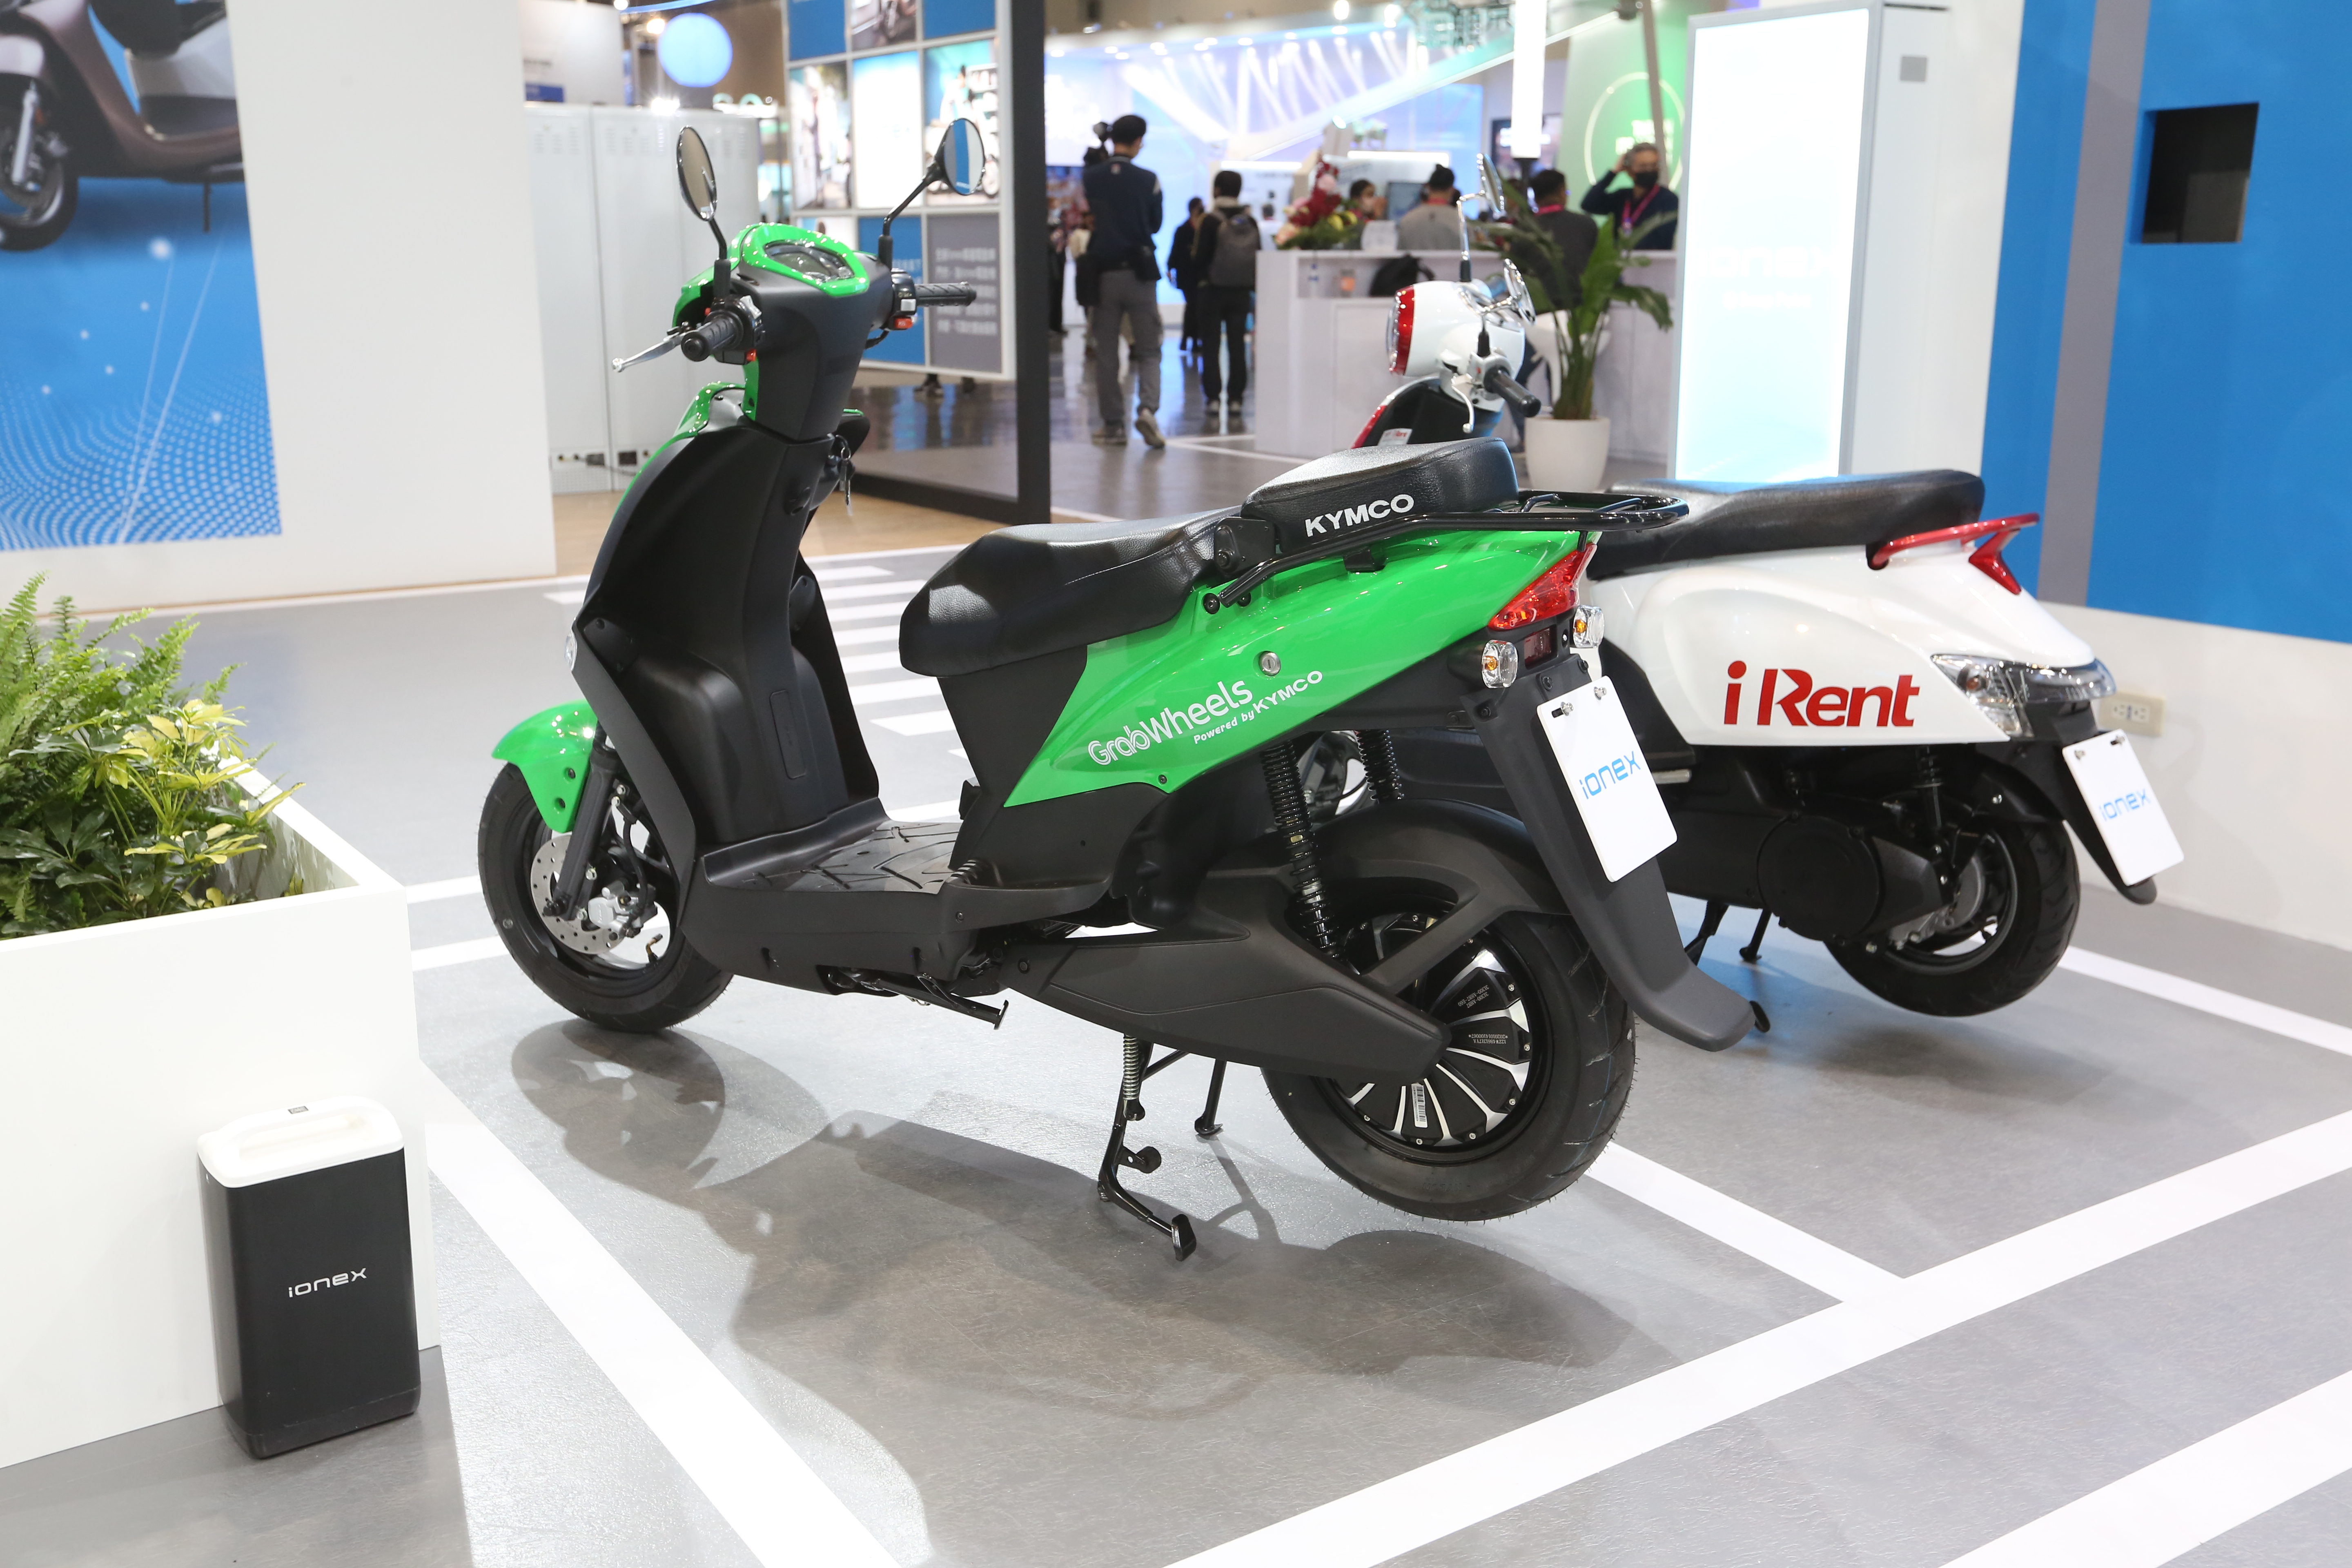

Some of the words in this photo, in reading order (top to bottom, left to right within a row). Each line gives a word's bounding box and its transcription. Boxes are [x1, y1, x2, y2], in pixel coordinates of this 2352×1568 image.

[1305, 494, 1414, 537] KYMCO
[1087, 679, 1253, 766] GrabWheels
[1193, 717, 1238, 744] Powered
[1241, 711, 1254, 722] by
[1252, 670, 1323, 714] KYMCO
[1579, 751, 1641, 800] ionex
[2099, 788, 2151, 821] ionex
[288, 1267, 367, 1298] ionex
